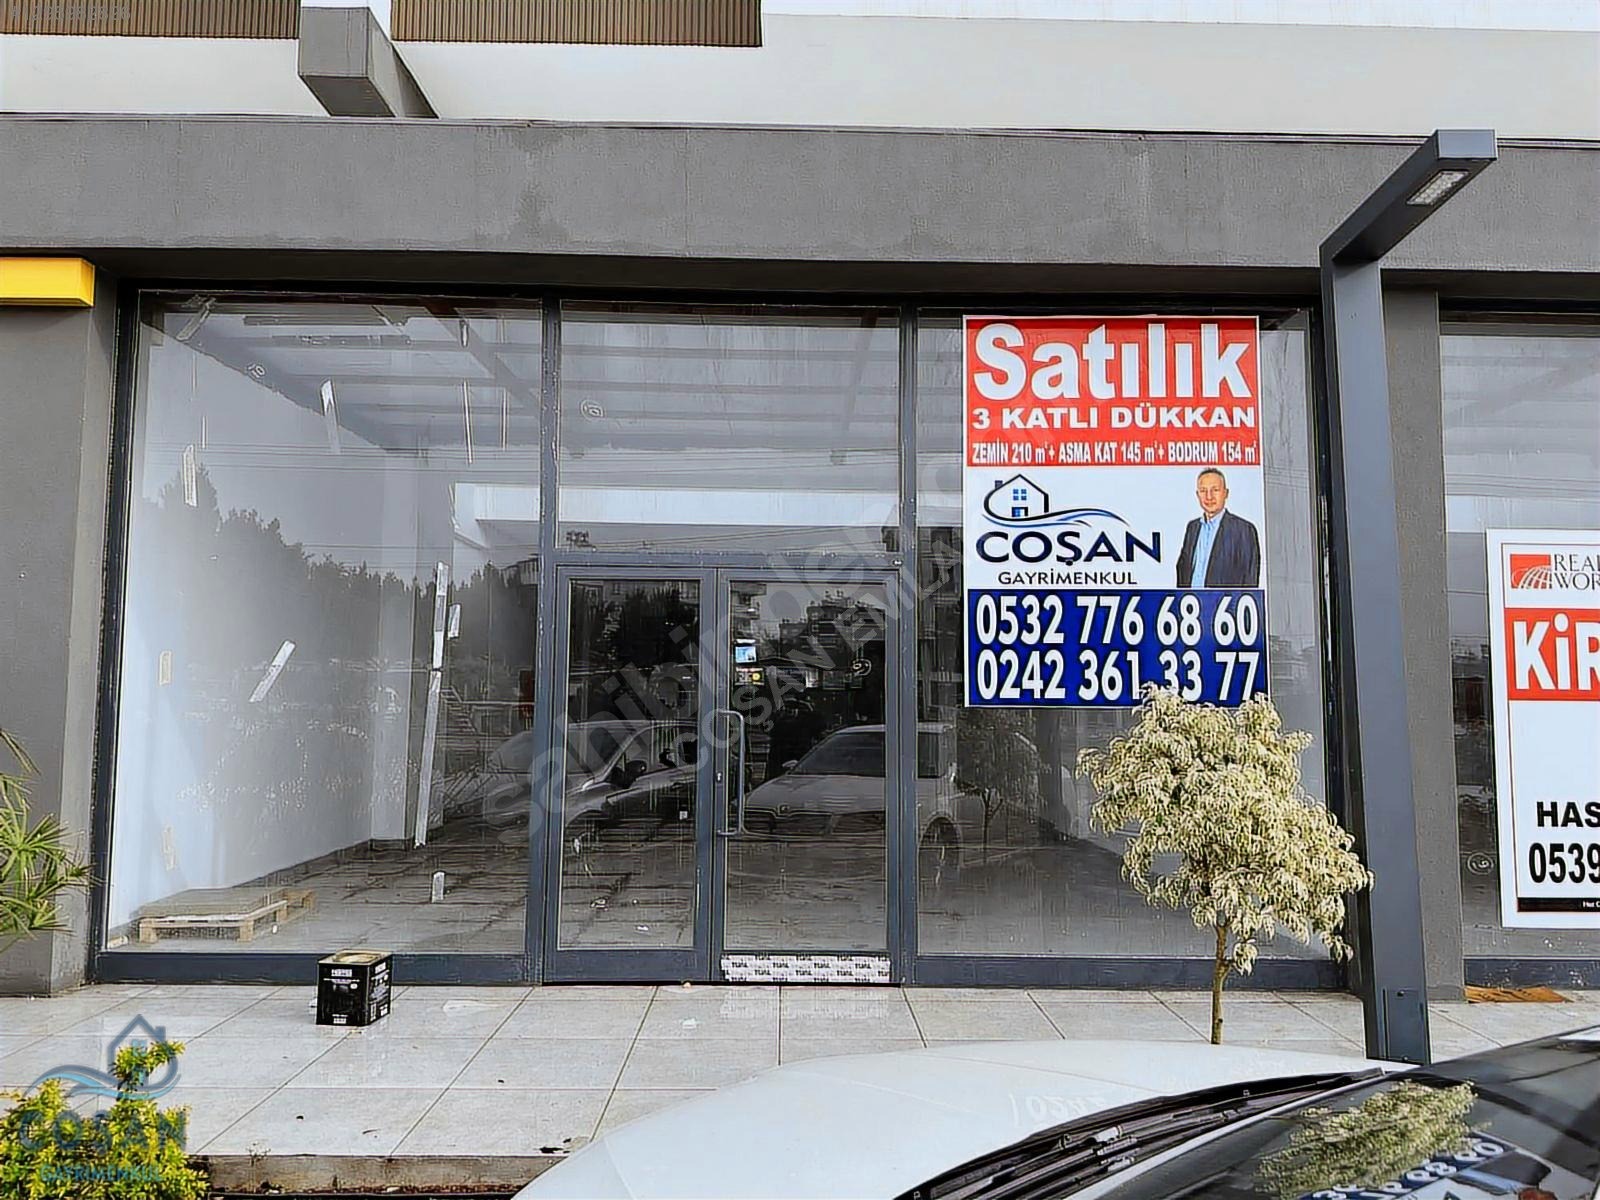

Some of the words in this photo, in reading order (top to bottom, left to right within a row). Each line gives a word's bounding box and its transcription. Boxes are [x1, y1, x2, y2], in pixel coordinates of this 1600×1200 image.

[973, 322, 1252, 400] Satılık
[972, 407, 991, 429] 3
[1002, 406, 1098, 429] KATLI
[1111, 402, 1254, 428] DÜKKAN
[972, 437, 1008, 463] ZEMİN
[1012, 443, 1032, 463] 210
[1059, 443, 1090, 463] ASMA
[1095, 443, 1117, 462] KAT
[1122, 443, 1140, 462] 145
[1168, 442, 1218, 462] BODRUM
[1222, 442, 1241, 462] 154
[976, 531, 1161, 566] COŞAN
[998, 568, 1137, 585] GAYRİMENKUL
[976, 594, 1064, 645] 0532
[1077, 595, 1144, 645] 776
[1157, 594, 1200, 646] 68
[1214, 594, 1259, 646] 60
[977, 649, 1065, 700] 0242
[1078, 650, 1140, 700] 361
[1159, 650, 1202, 700] 33
[1215, 652, 1260, 701] 77
[1536, 801, 1600, 828] HAS
[1528, 842, 1600, 884] 0539
